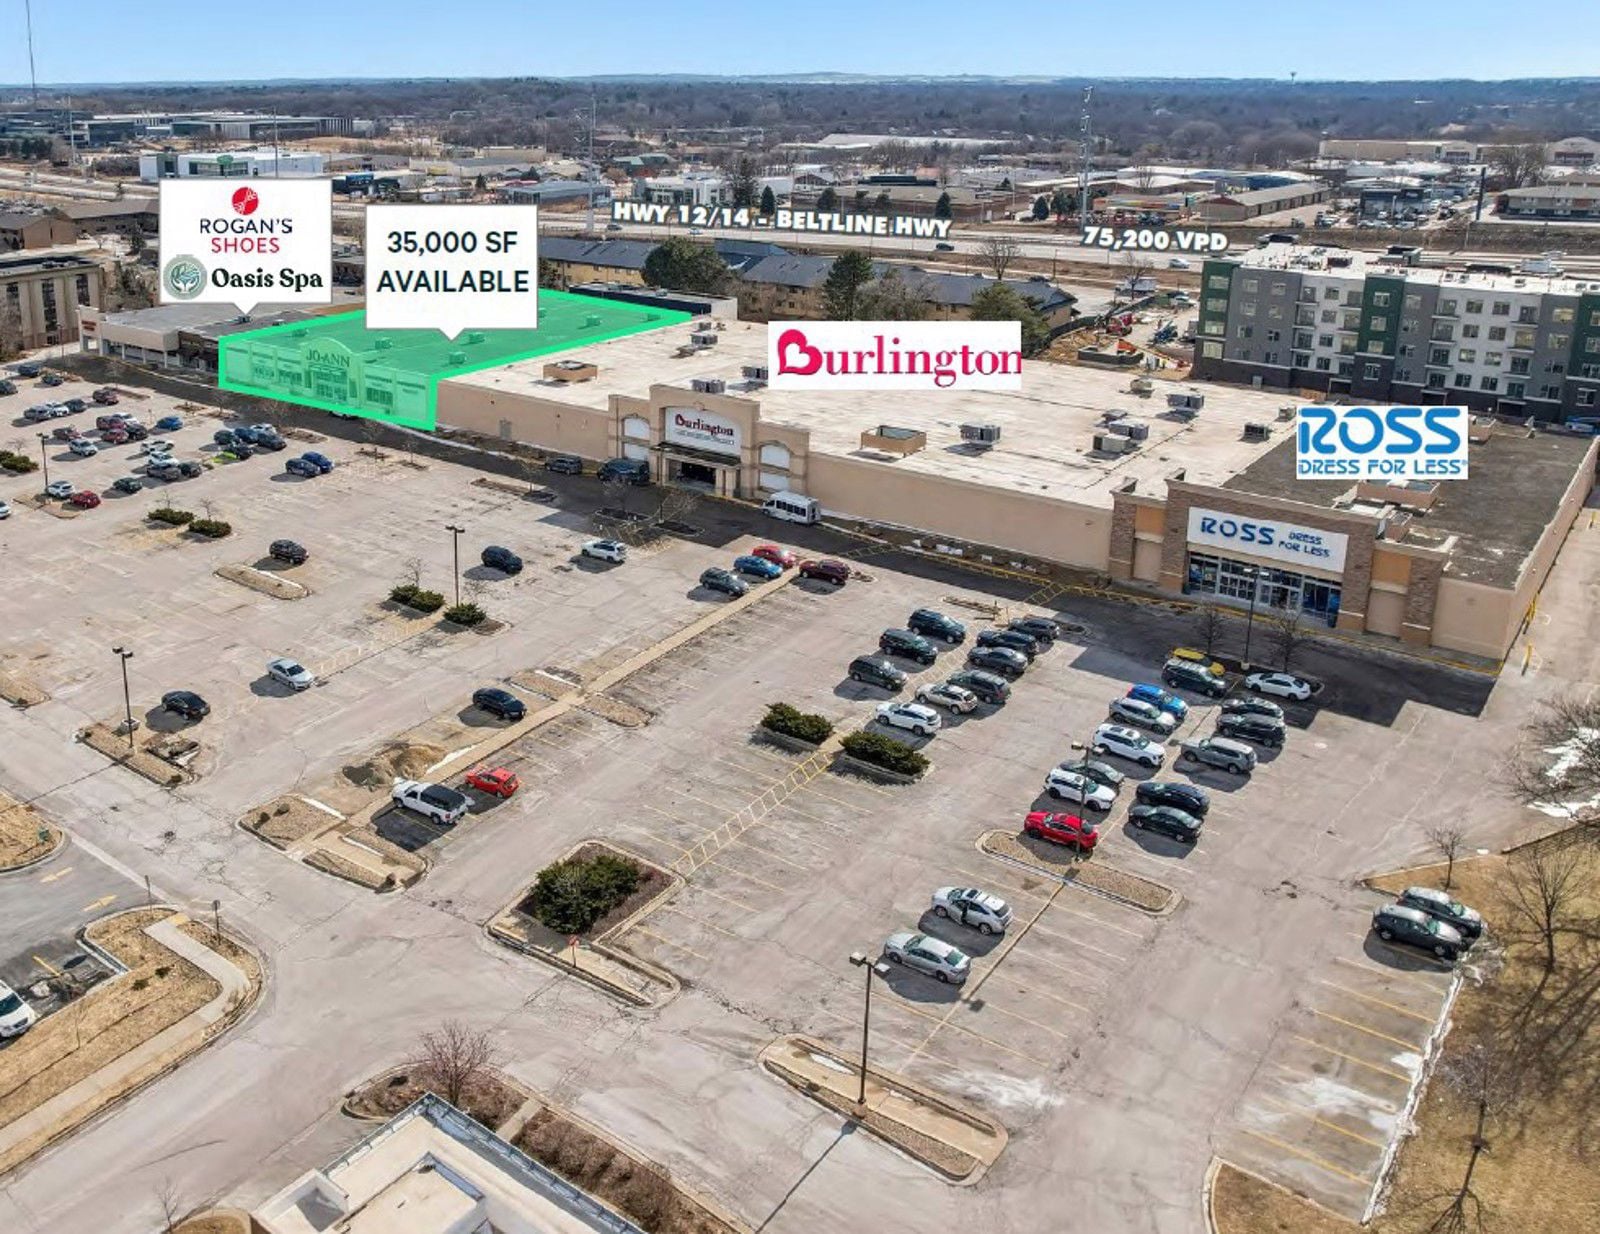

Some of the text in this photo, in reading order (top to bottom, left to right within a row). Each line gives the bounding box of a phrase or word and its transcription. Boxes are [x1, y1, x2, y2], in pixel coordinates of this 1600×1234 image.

[675, 413, 734, 436] Burlington
[1201, 517, 1274, 545] ROSS
[1289, 531, 1322, 545] DRESS
[1279, 541, 1330, 558] FOR LESS
